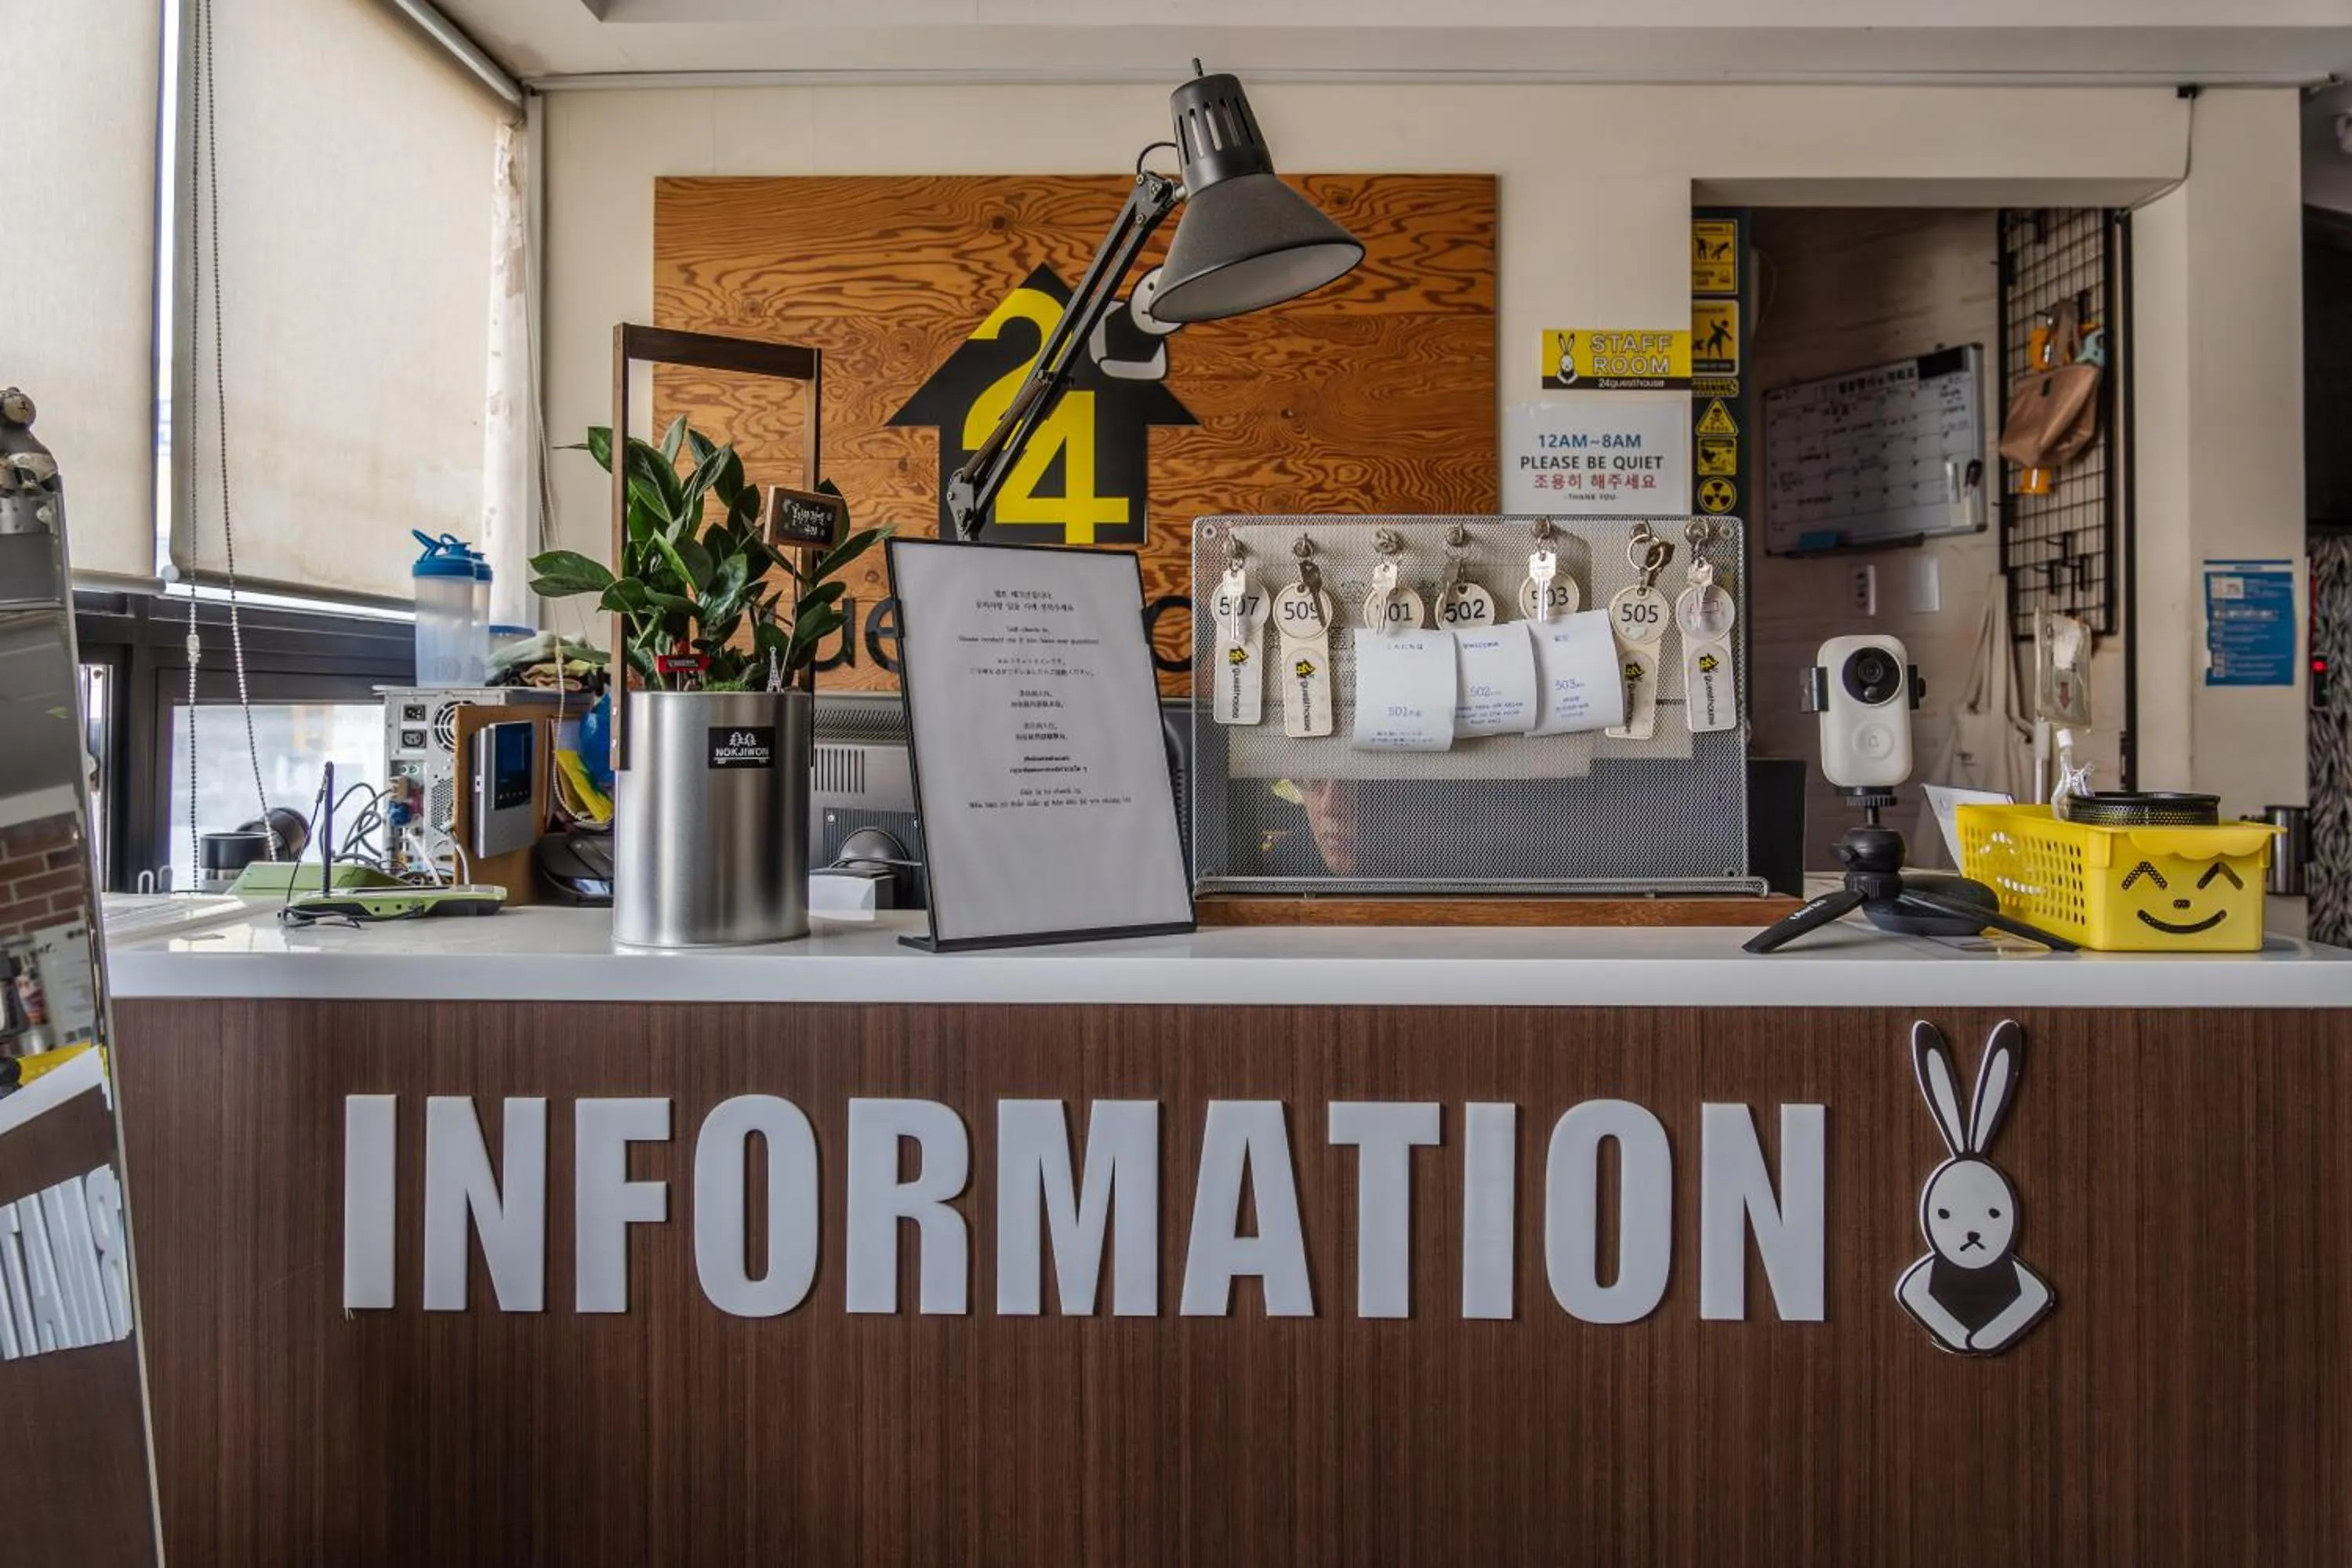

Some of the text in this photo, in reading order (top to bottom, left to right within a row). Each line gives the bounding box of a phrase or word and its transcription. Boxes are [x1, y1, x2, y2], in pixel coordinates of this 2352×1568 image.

[1591, 334, 1672, 354] STAFF
[1593, 355, 1669, 375] ROOM
[1598, 379, 1665, 389] 24guesthouse
[962, 288, 1130, 545] 24
[1538, 434, 1642, 448] 12AM~8AM
[1520, 456, 1664, 471] PLEASE BE QUIET
[1534, 474, 1657, 490] 조용히 해주세요
[1377, 603, 1413, 621] 01
[1445, 599, 1486, 622] 502
[1622, 604, 1659, 623] 505
[715, 747, 770, 757] NOKJIWON
[343, 1094, 1826, 1325] INFORMATION
